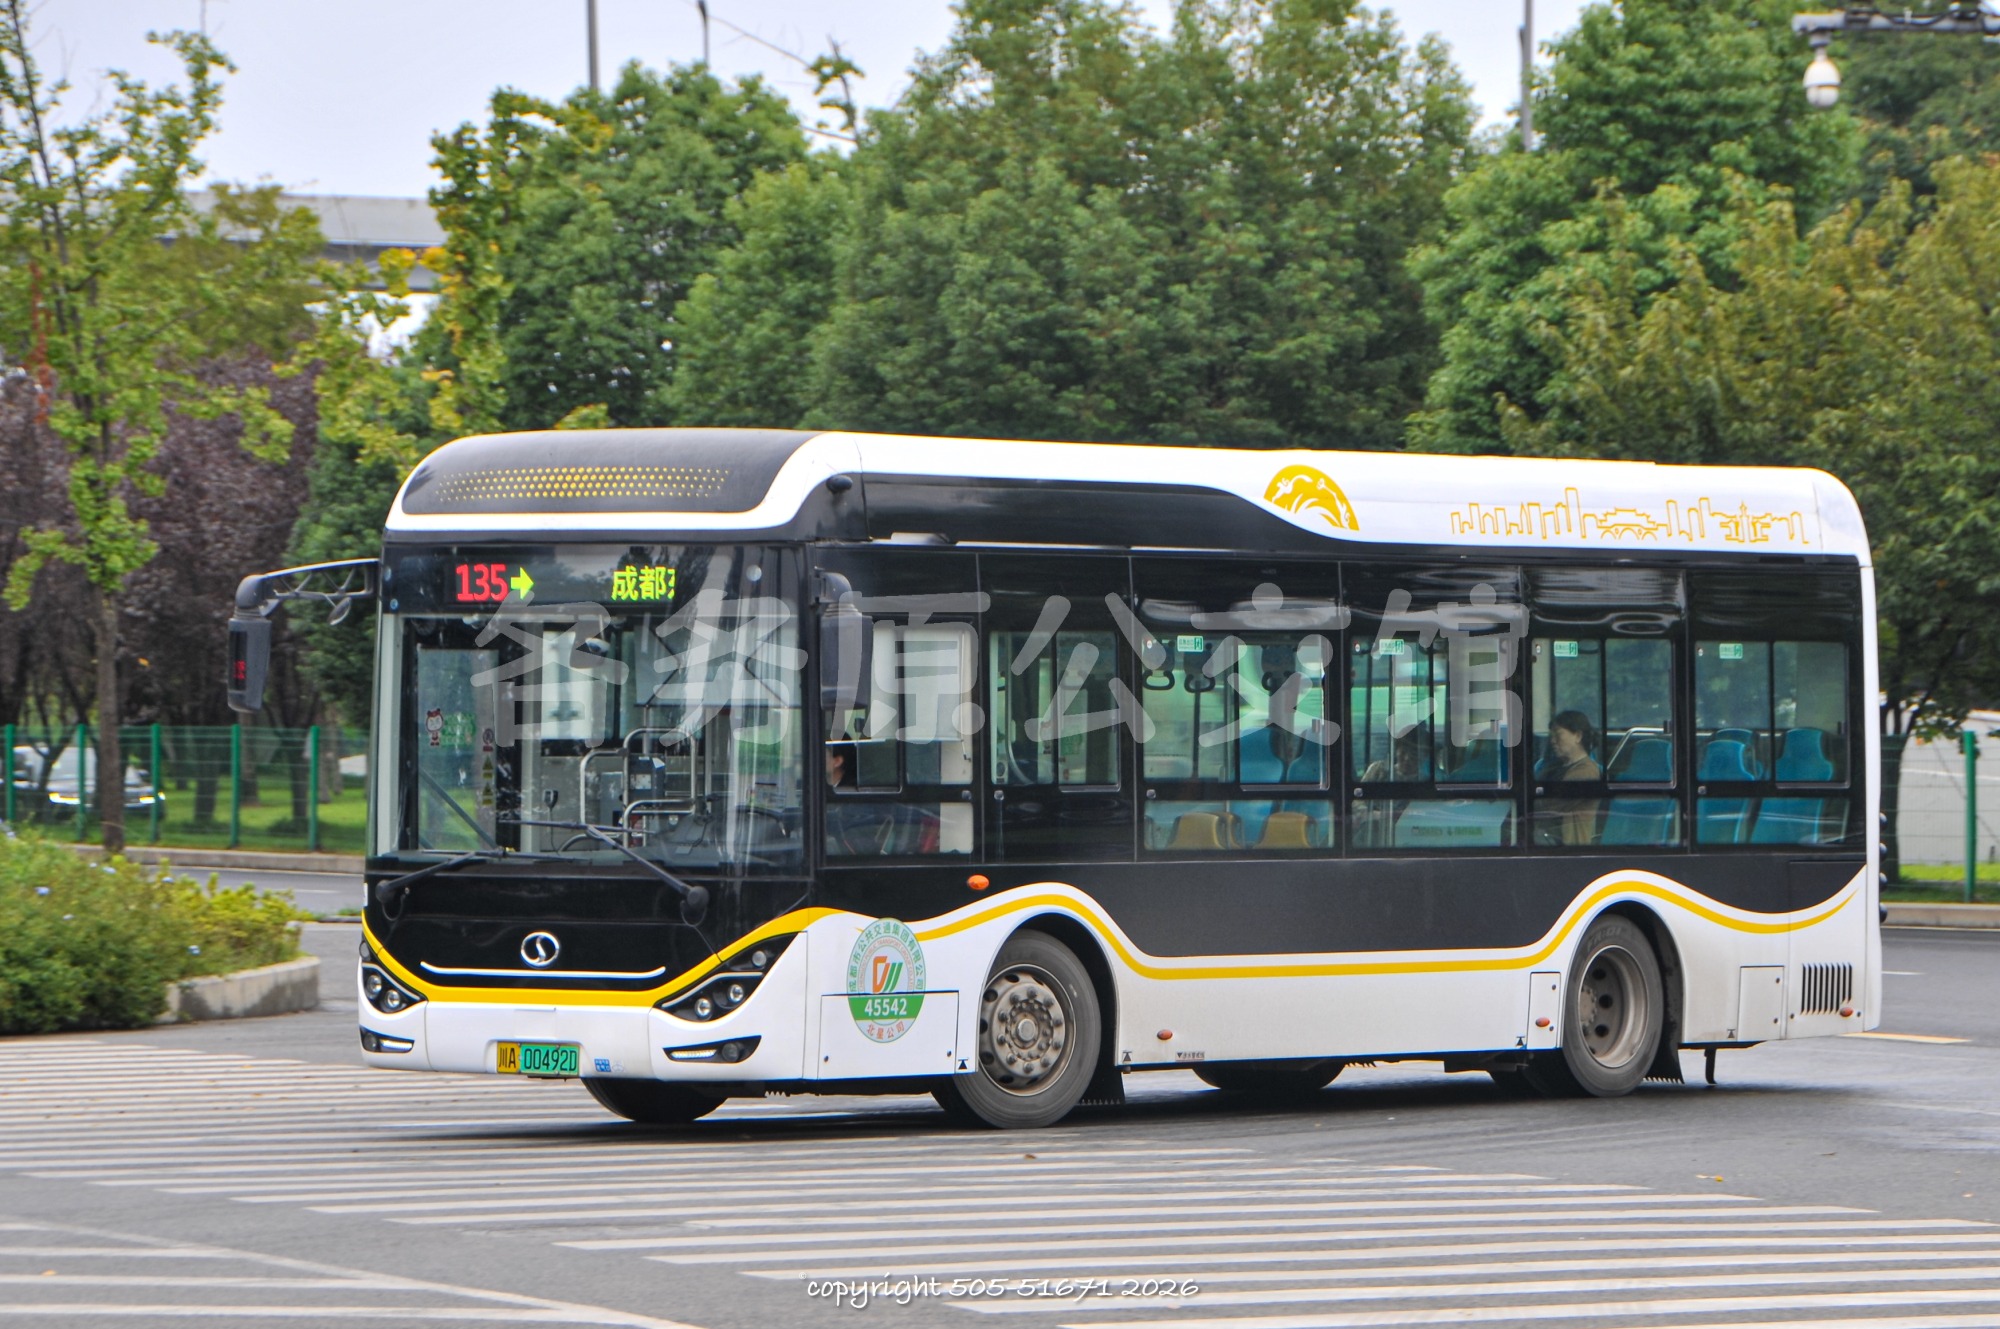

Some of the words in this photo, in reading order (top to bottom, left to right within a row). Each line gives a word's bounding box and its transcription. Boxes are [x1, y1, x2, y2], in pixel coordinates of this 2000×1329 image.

[455, 563, 509, 602] 135
[849, 921, 924, 993] 成都市公共交通集团有限公司
[864, 998, 907, 1017] 45542
